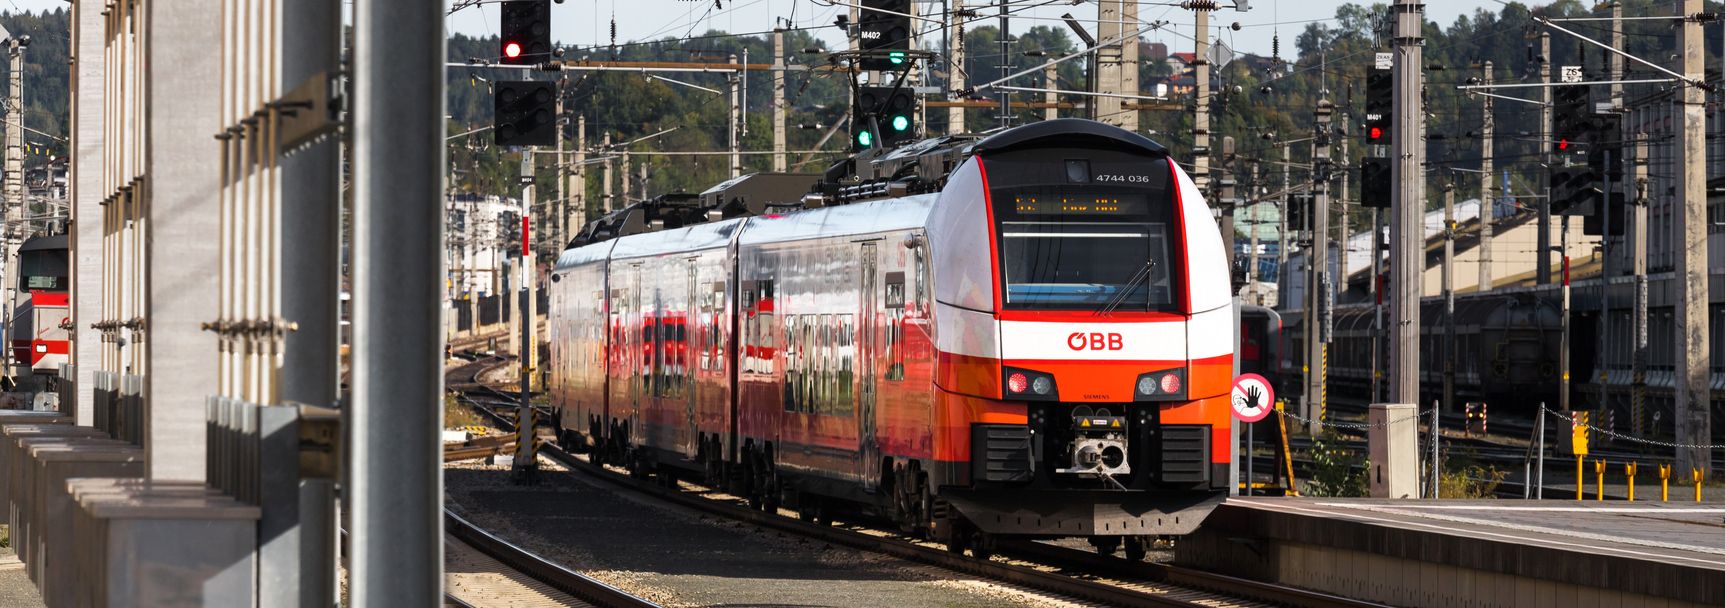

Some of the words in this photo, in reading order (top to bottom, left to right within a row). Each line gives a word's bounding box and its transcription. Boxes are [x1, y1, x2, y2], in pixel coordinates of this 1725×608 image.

[861, 31, 881, 39] M402
[1096, 174, 1125, 182] 4744
[1128, 175, 1149, 183] 036
[1067, 332, 1124, 351] ÖBB
